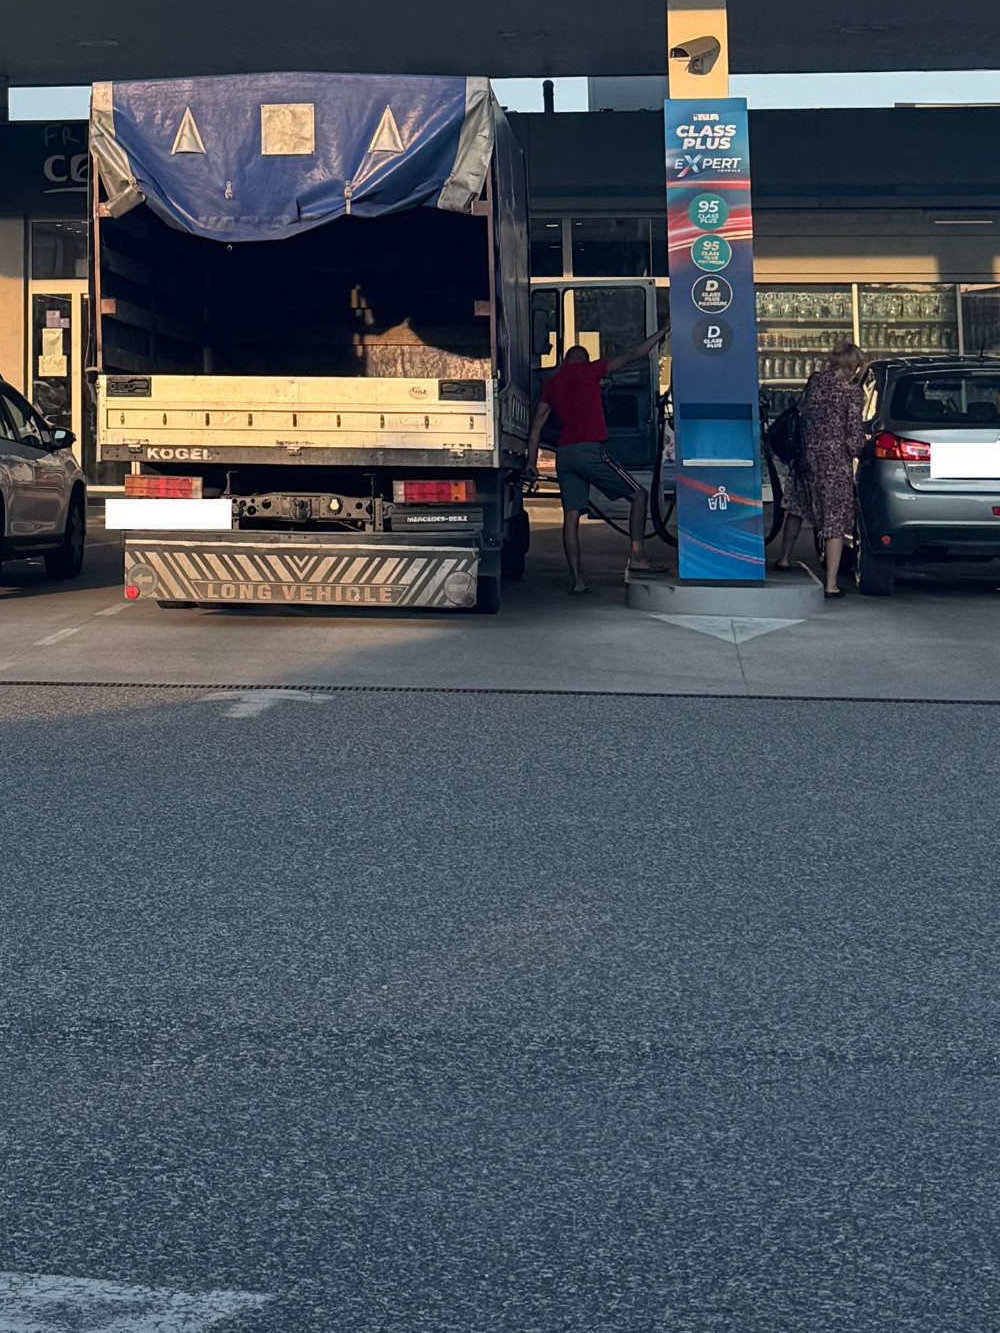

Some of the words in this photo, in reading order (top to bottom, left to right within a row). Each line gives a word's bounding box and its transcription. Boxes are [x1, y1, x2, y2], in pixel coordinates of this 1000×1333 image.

[676, 124, 737, 138] CLASS
[682, 137, 731, 150] PLUS
[698, 200, 719, 213] 95
[702, 240, 720, 251] 95
[705, 280, 719, 292] D
[707, 325, 721, 338] D
[206, 582, 272, 601] LONG
[281, 584, 393, 603] VEHICLE
